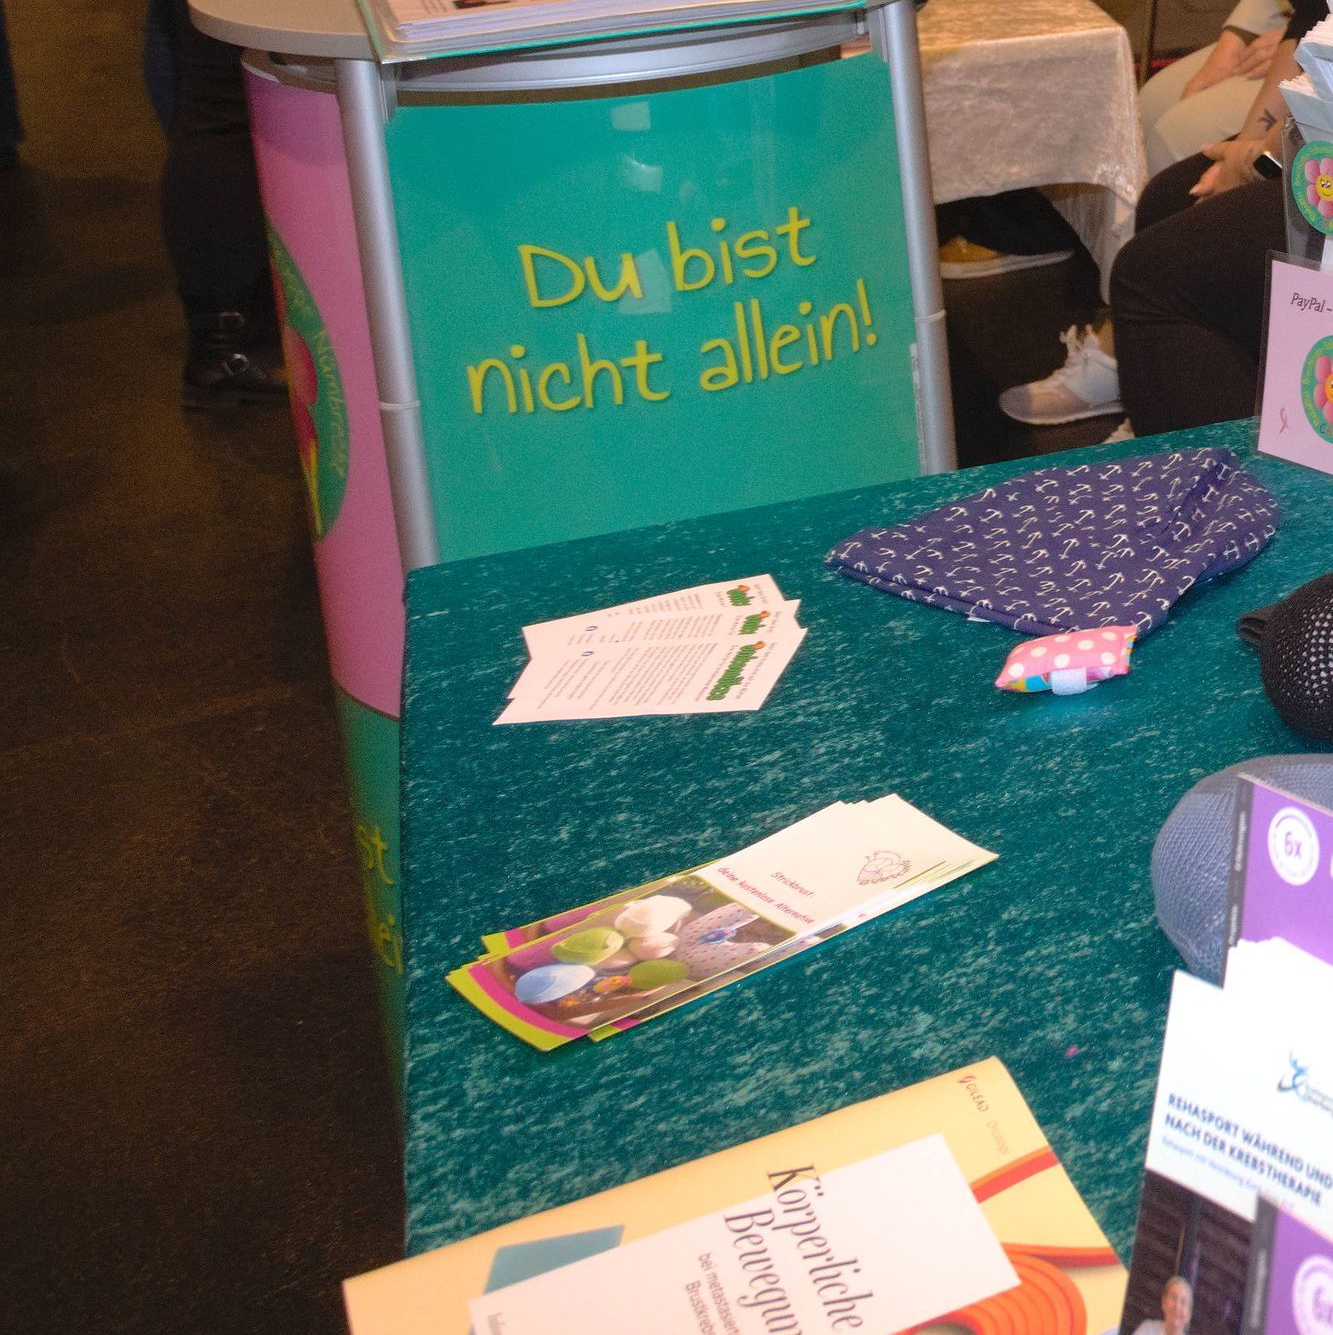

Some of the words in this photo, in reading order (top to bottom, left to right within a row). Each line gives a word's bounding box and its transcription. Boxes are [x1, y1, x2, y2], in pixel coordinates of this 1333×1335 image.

[517, 244, 645, 309] Du
[665, 205, 818, 294] bist
[1290, 292, 1326, 312] PayPal
[465, 332, 671, 415] nicht
[699, 278, 878, 393] allein!
[1283, 828, 1303, 860] 6x
[967, 1081, 990, 1114] GILEAD
[1168, 1093, 1239, 1138] REHASPORT
[1242, 1127, 1304, 1172] WÄHREND
[1306, 1165, 1333, 1191] UND
[1164, 1113, 1201, 1141] NACH
[1203, 1128, 1226, 1154] DER
[1228, 1145, 1322, 1208] KREBSTHERAPIE
[698, 1252, 713, 1270] bei
[766, 1163, 874, 1330] Körperliche
